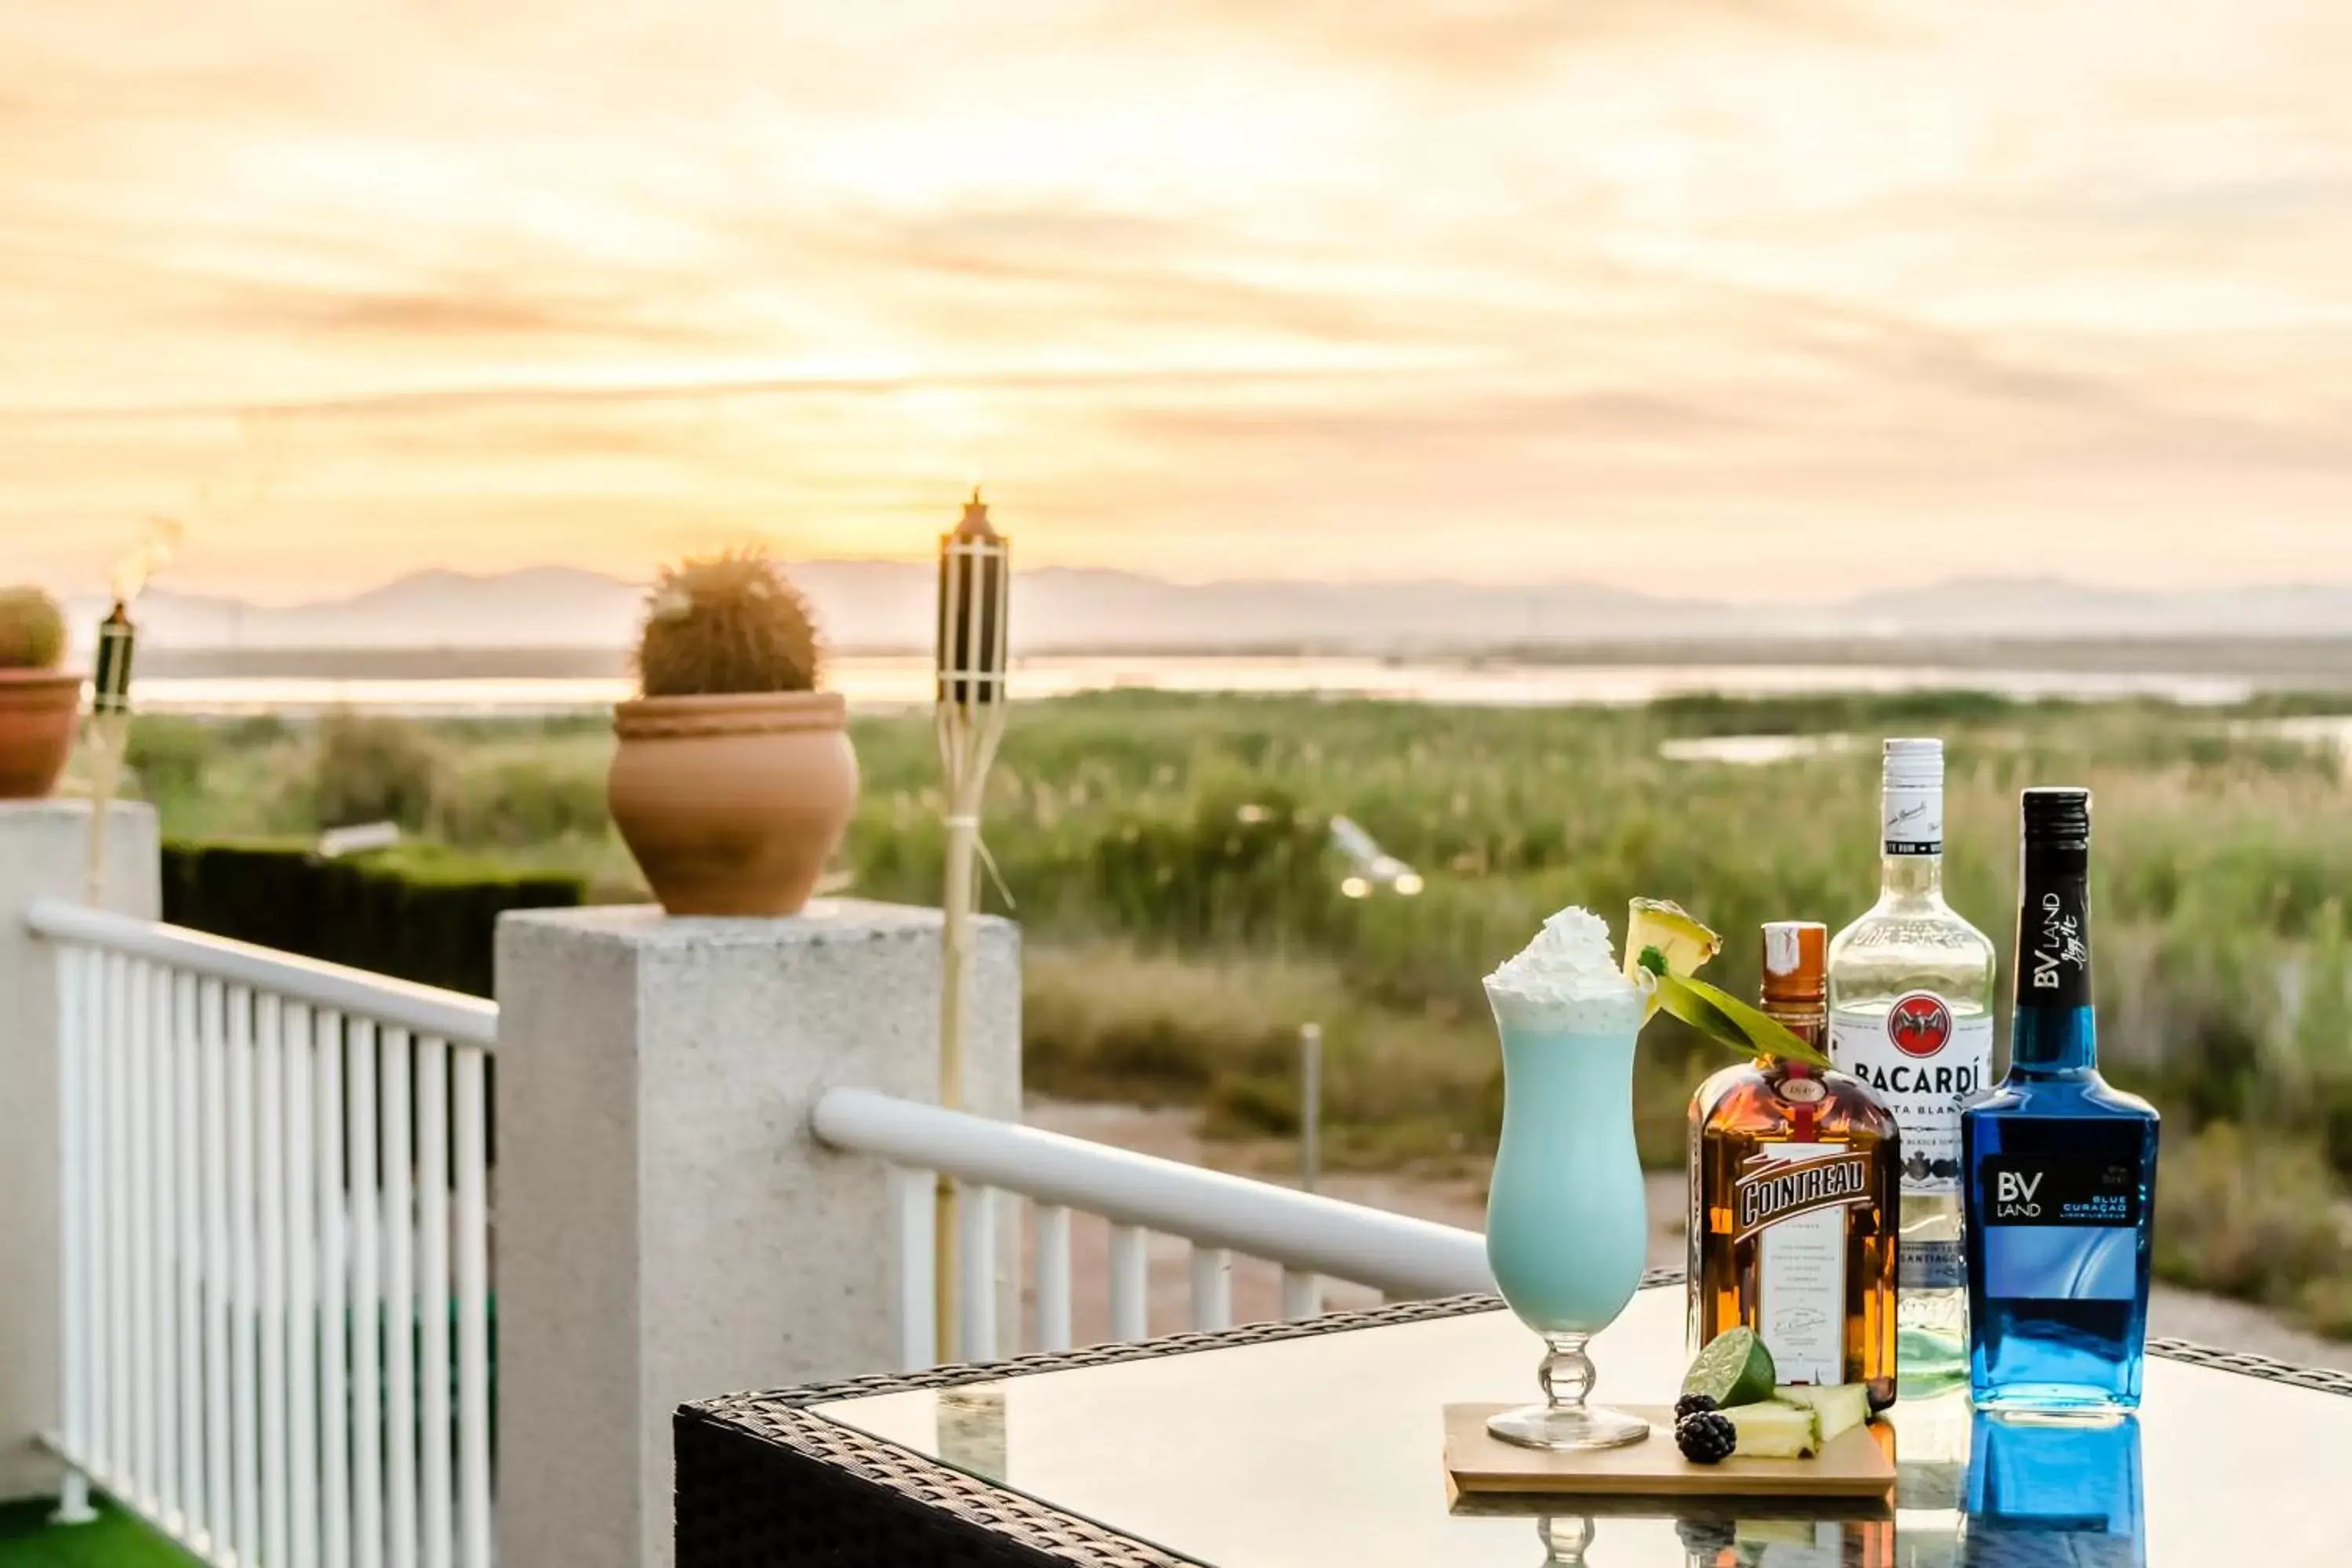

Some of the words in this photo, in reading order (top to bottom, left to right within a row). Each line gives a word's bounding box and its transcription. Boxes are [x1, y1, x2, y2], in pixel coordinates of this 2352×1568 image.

[2042, 893, 2060, 948] LAND
[2034, 949, 2060, 988] BV
[1855, 1056, 1980, 1094] BACARDÍ
[1740, 1161, 1865, 1229] COINTREAU
[1998, 1172, 2043, 1202] BV
[1997, 1203, 2041, 1217] LAND
[2063, 1203, 2127, 1213] CURAÇAO
